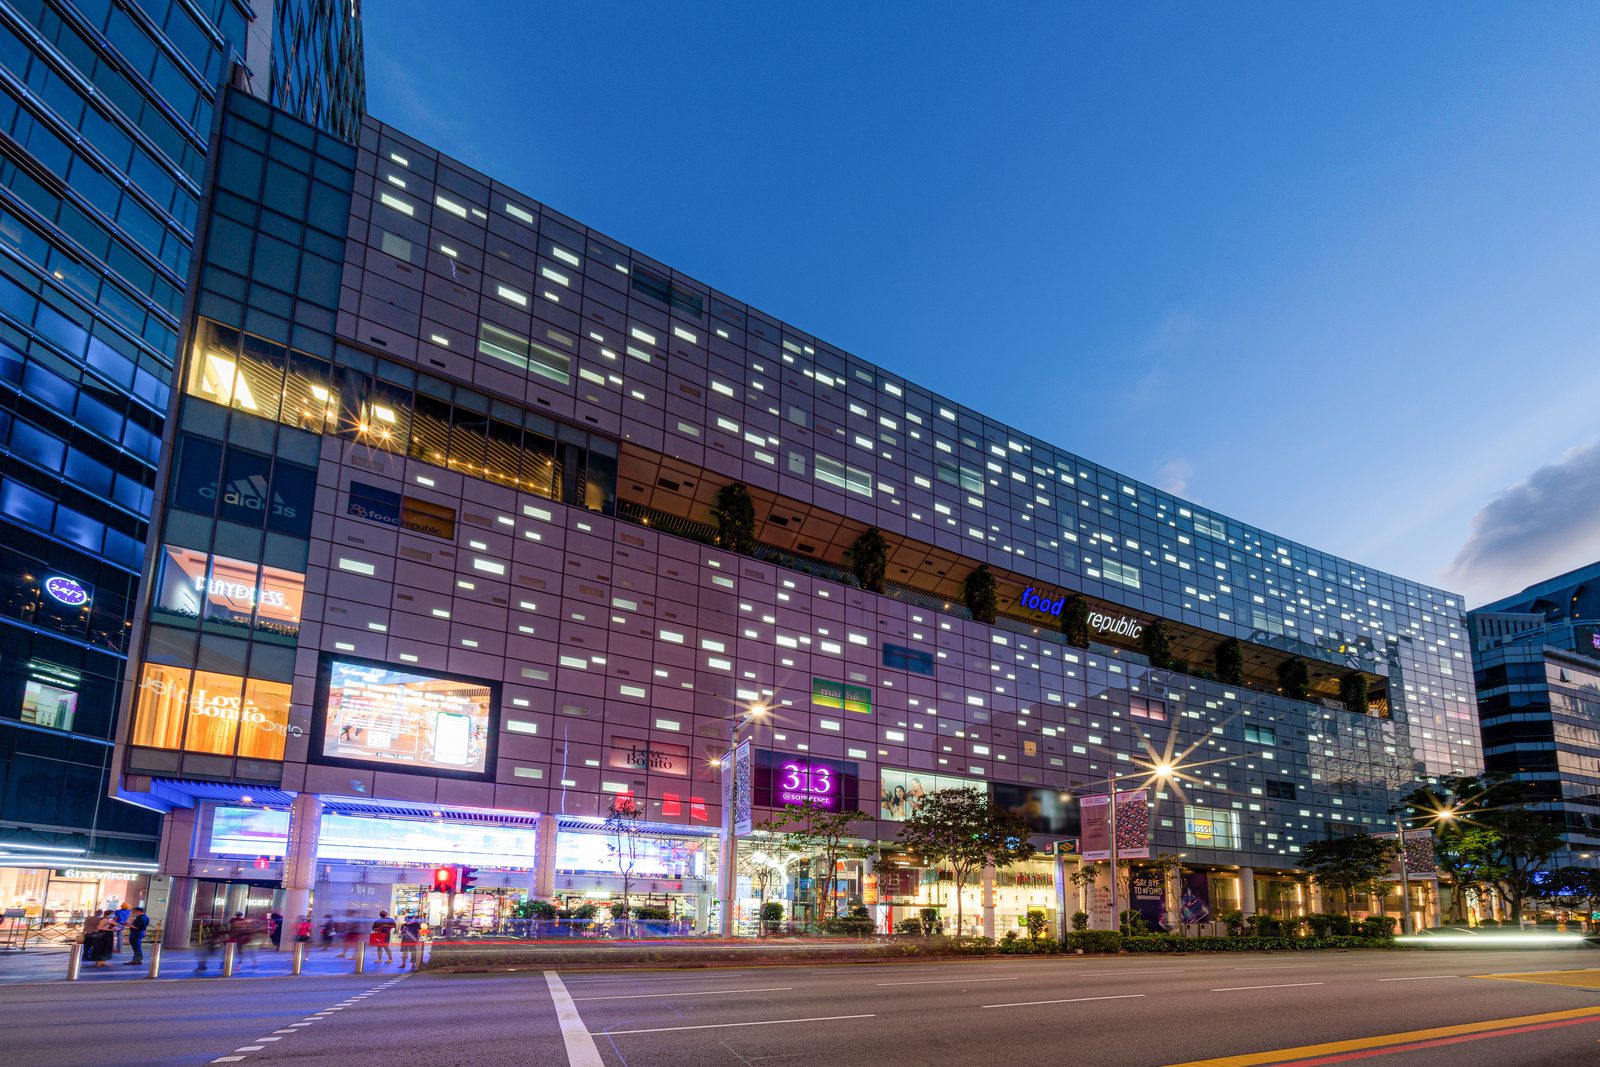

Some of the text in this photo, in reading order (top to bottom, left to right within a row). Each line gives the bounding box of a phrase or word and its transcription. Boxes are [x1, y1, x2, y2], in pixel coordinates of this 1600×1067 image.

[198, 487, 297, 518] adidas
[368, 510, 442, 536] food republic
[1020, 587, 1143, 639] food republic
[625, 754, 673, 770] Bonito
[782, 764, 831, 793] 313
[782, 792, 830, 804] @somerset
[1134, 886, 1142, 895] TO
